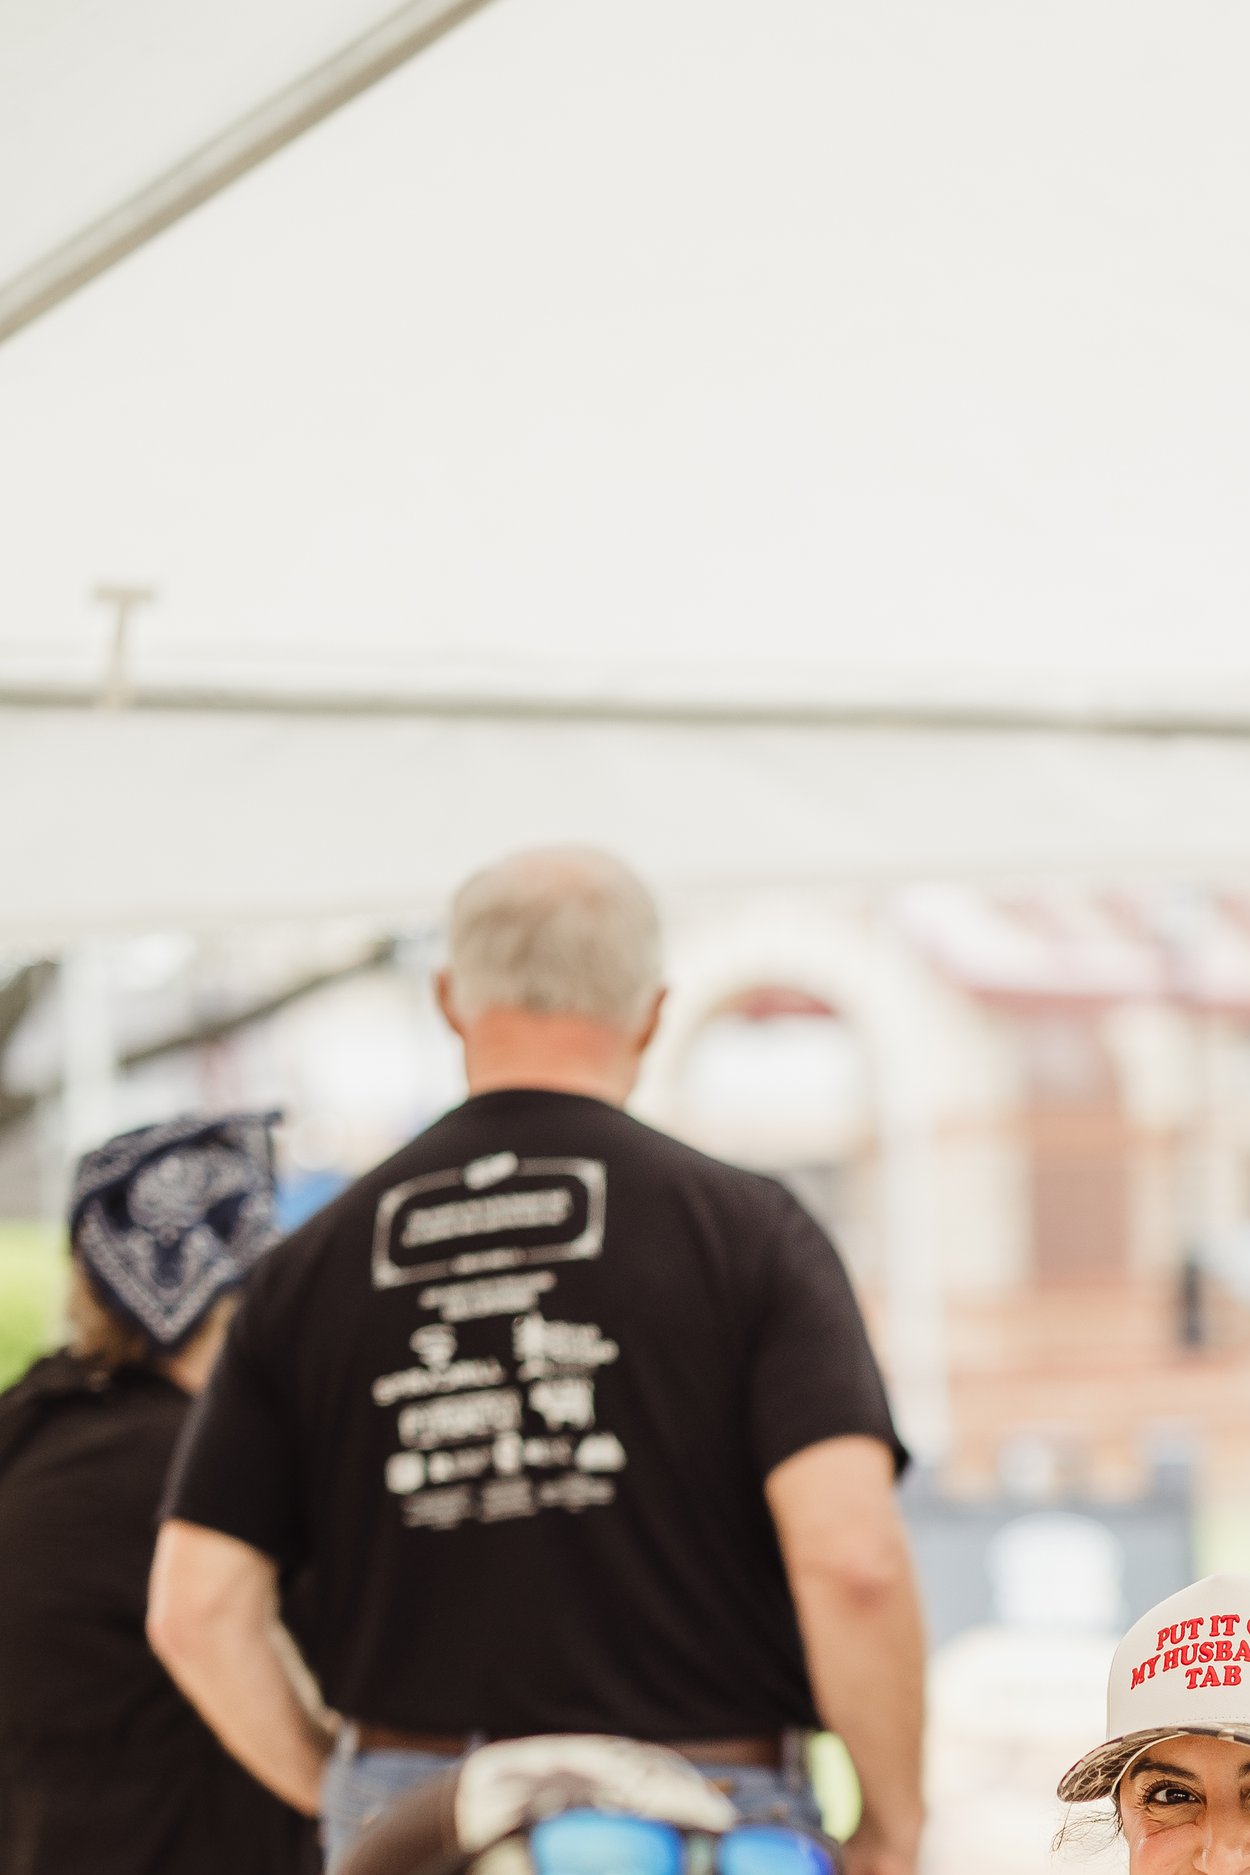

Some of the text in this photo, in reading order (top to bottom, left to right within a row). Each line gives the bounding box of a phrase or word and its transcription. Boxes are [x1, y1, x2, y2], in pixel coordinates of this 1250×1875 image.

[1155, 1617, 1204, 1651] PUT
[1208, 1614, 1240, 1637] IT
[1130, 1654, 1161, 1690] MY
[1184, 1665, 1242, 1690] TAB
